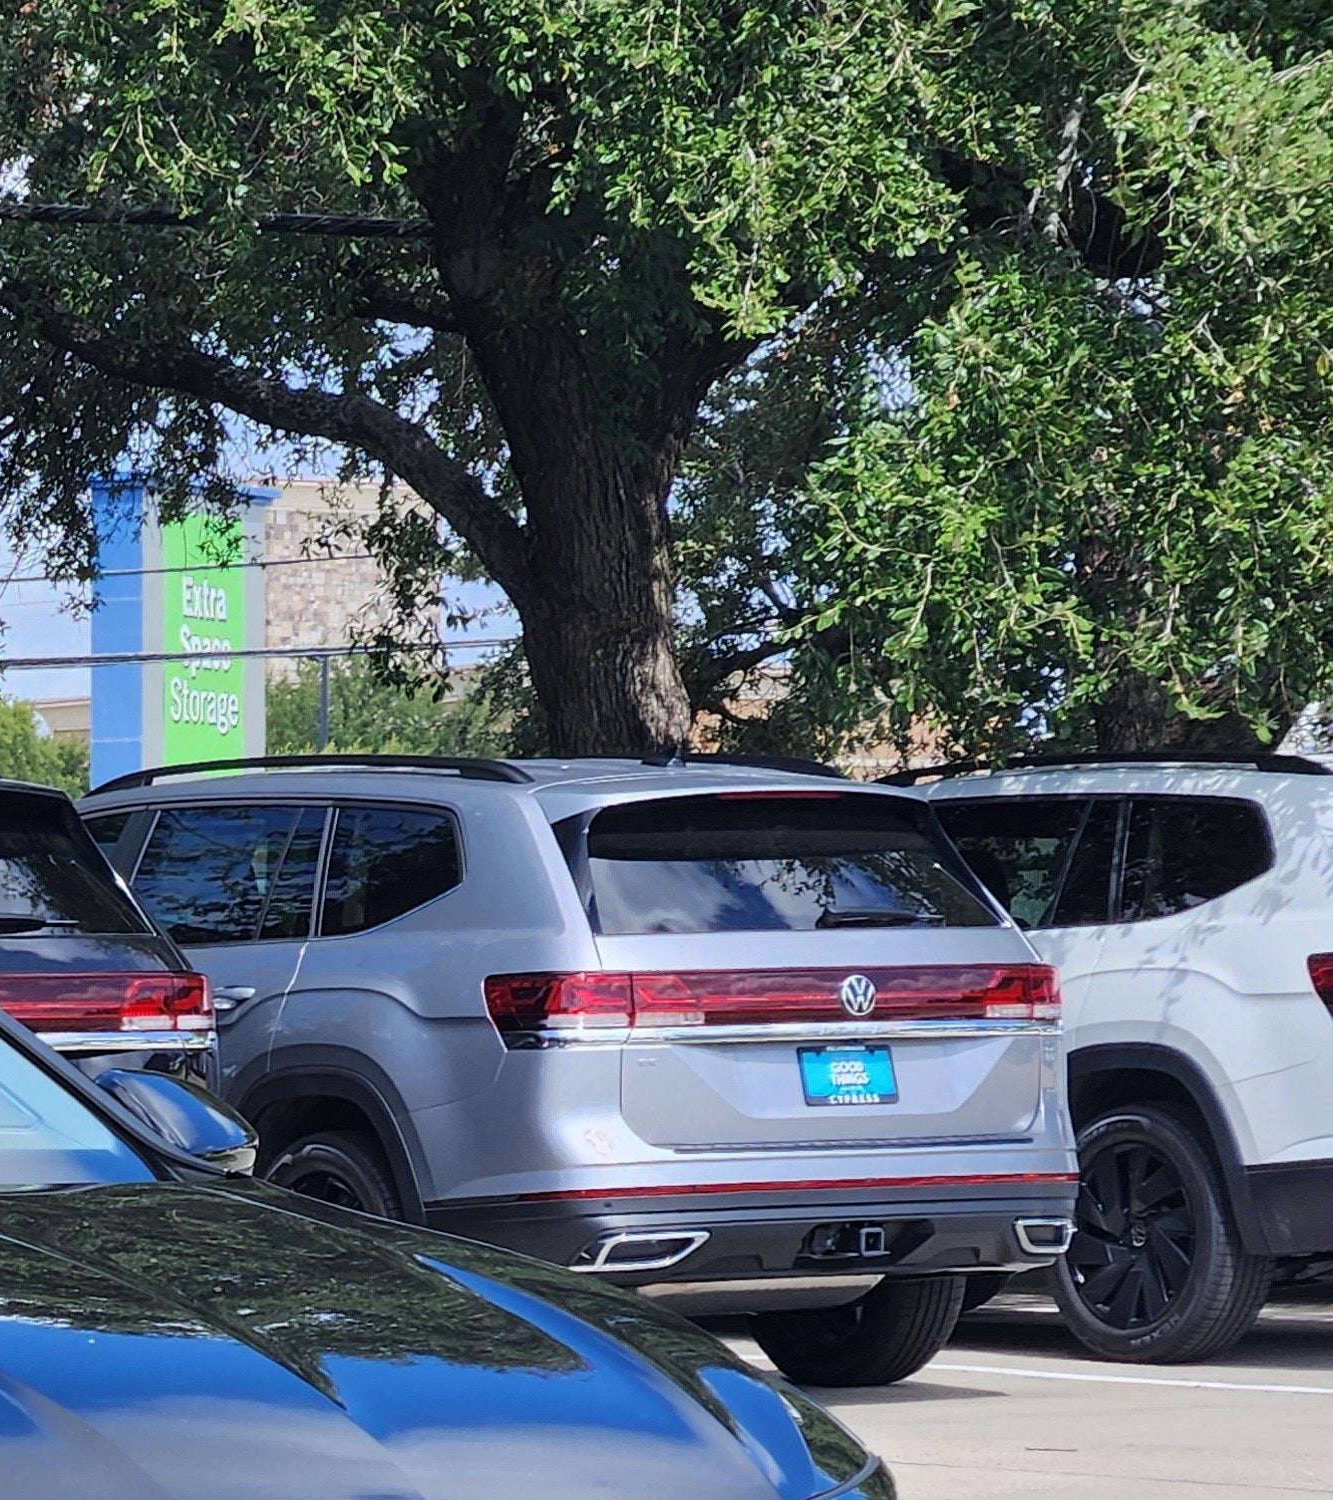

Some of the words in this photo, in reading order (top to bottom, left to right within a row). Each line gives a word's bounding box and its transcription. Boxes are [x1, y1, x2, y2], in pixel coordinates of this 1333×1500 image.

[181, 576, 228, 621] Extra
[180, 624, 232, 678] Space
[170, 676, 240, 735] Storage
[829, 1072, 871, 1086] THINGS
[830, 1061, 865, 1073] GOOD
[830, 1093, 881, 1104] CYPRESS
